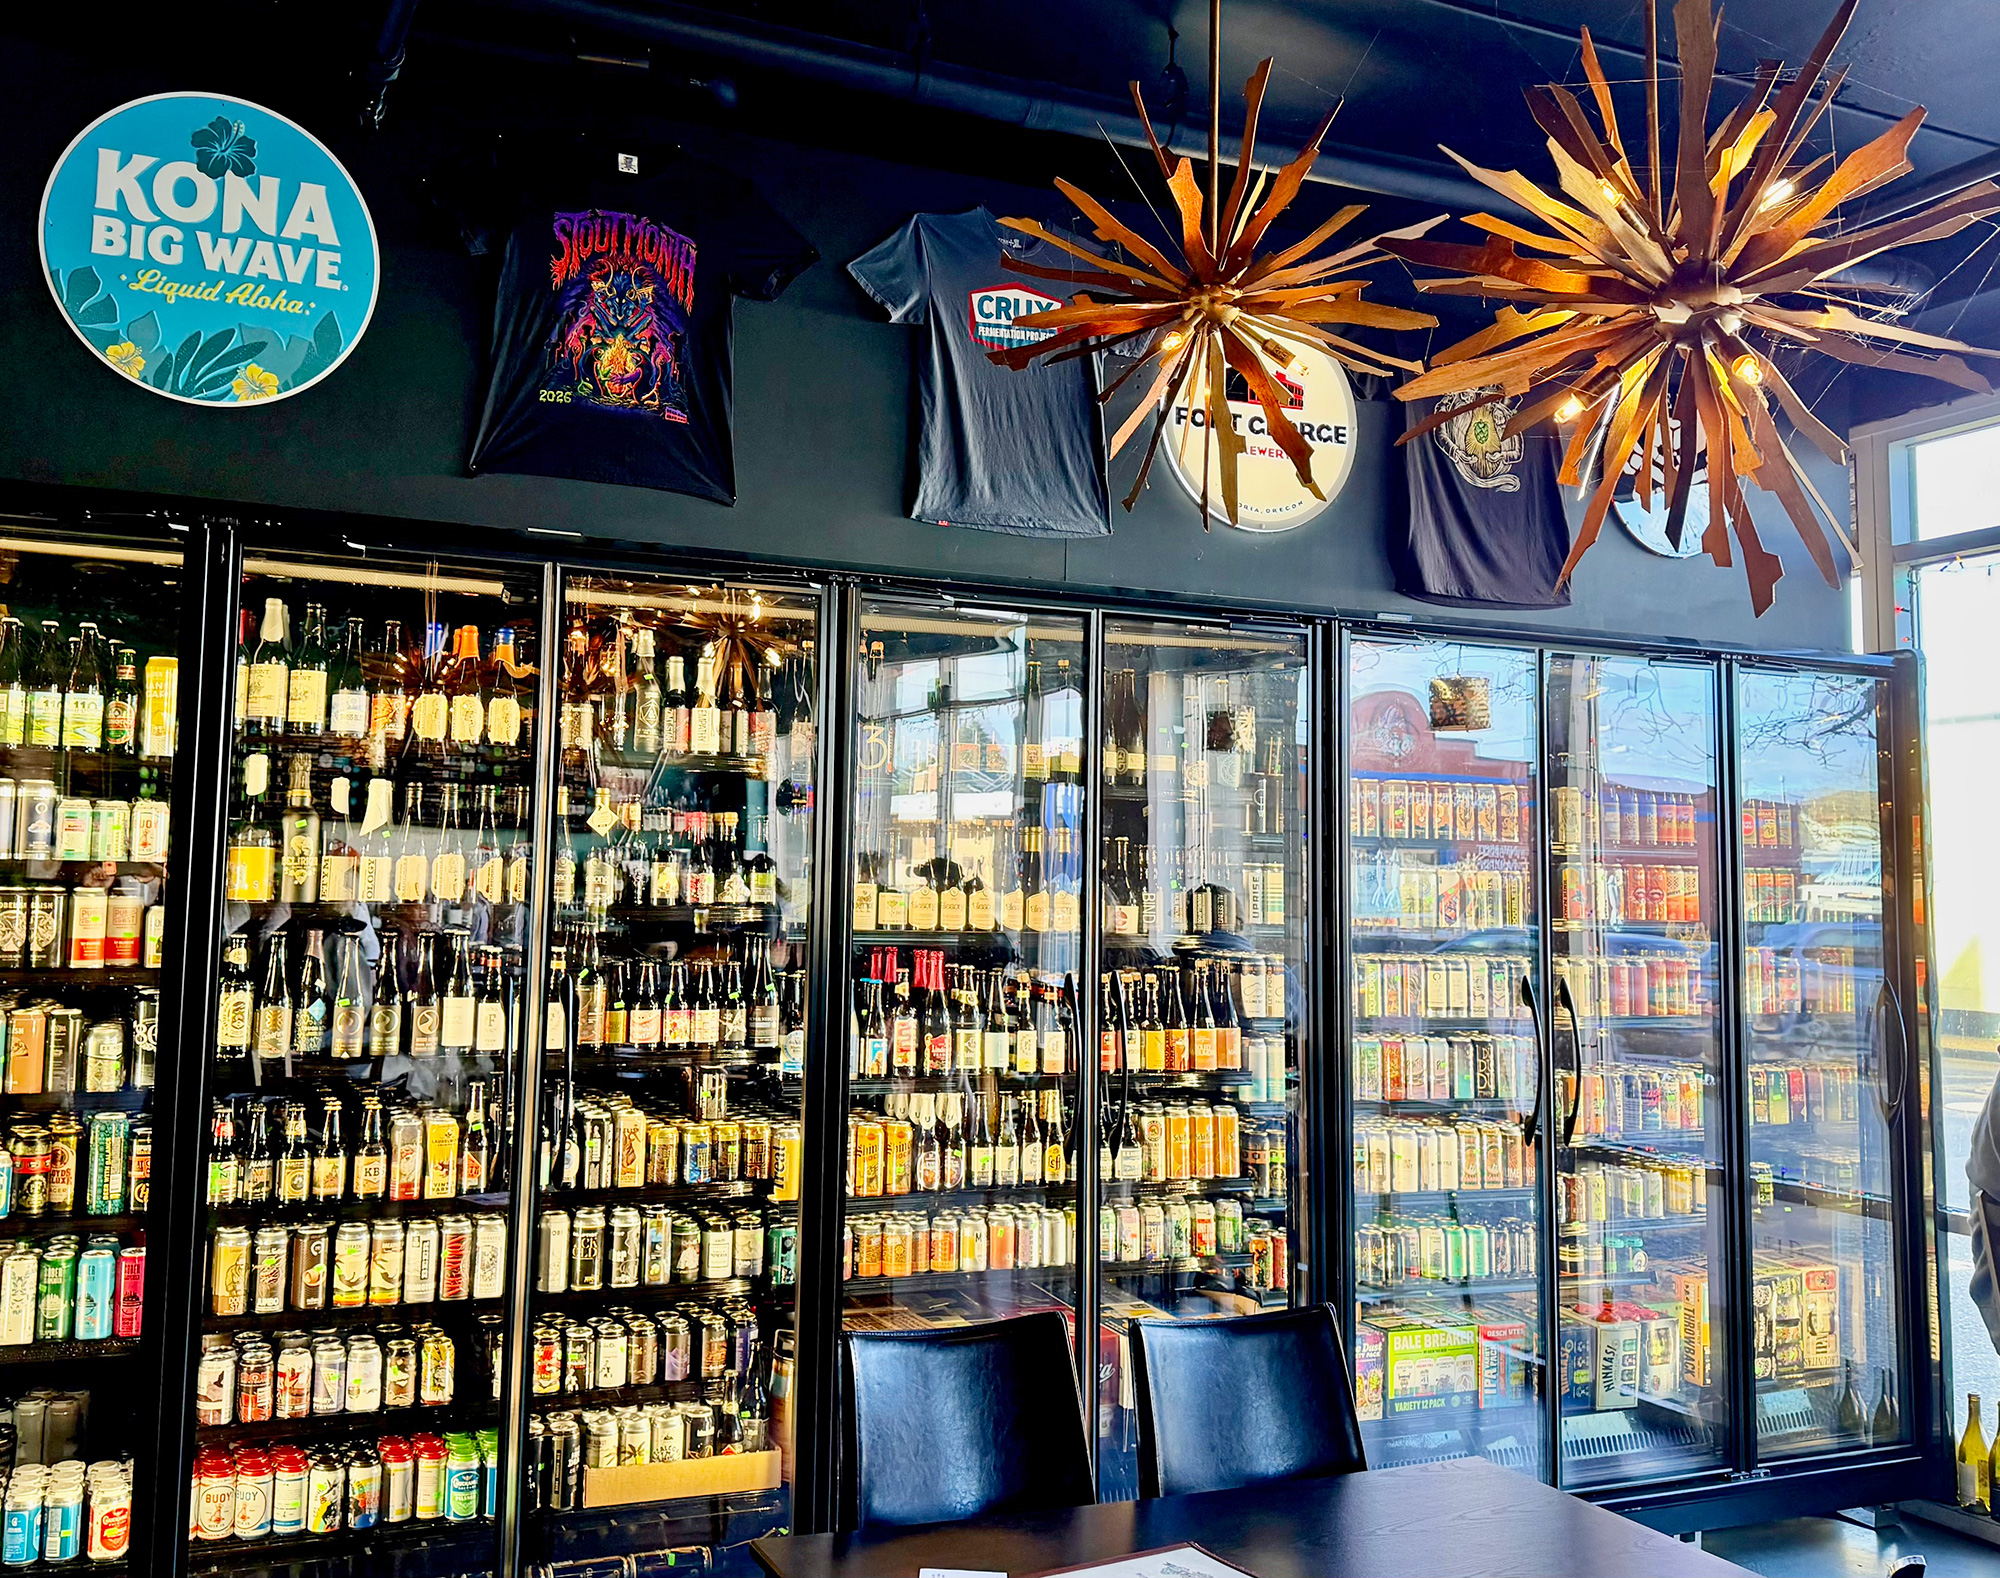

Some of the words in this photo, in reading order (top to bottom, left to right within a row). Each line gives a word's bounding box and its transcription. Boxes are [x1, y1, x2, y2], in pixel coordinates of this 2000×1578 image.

[94, 147, 341, 248] KONA
[90, 214, 184, 266] BIG
[550, 208, 634, 290] STOUT
[622, 217, 698, 317] MONTH
[129, 269, 220, 305] Liquid
[224, 283, 304, 315] Aloha
[977, 294, 1054, 320] CRUX
[978, 326, 1025, 341] FERMENTATION
[539, 389, 572, 404] 2026
[1175, 406, 1243, 432] FOT
[320, 858, 330, 899] ETYM
[366, 858, 375, 900] OLOGY
[1142, 892, 1156, 924] BIND
[1252, 876, 1260, 919] UPRISE
[487, 1014, 496, 1027] F
[363, 1167, 380, 1178] KB
[1394, 1332, 1422, 1351] BALE
[1424, 1329, 1475, 1349] BREAKER
[1683, 1306, 1696, 1379] THROWBACK
[1815, 1336, 1829, 1355] IPA
[1602, 1344, 1617, 1393] NINKASI
[1803, 1355, 1840, 1367] LAGUNITAS
[1484, 1368, 1498, 1395] IPA
[1394, 1400, 1421, 1413] VARIETY
[1421, 1399, 1429, 1410] 12
[1428, 1397, 1446, 1410] PACK
[205, 1491, 232, 1504] BUOY
